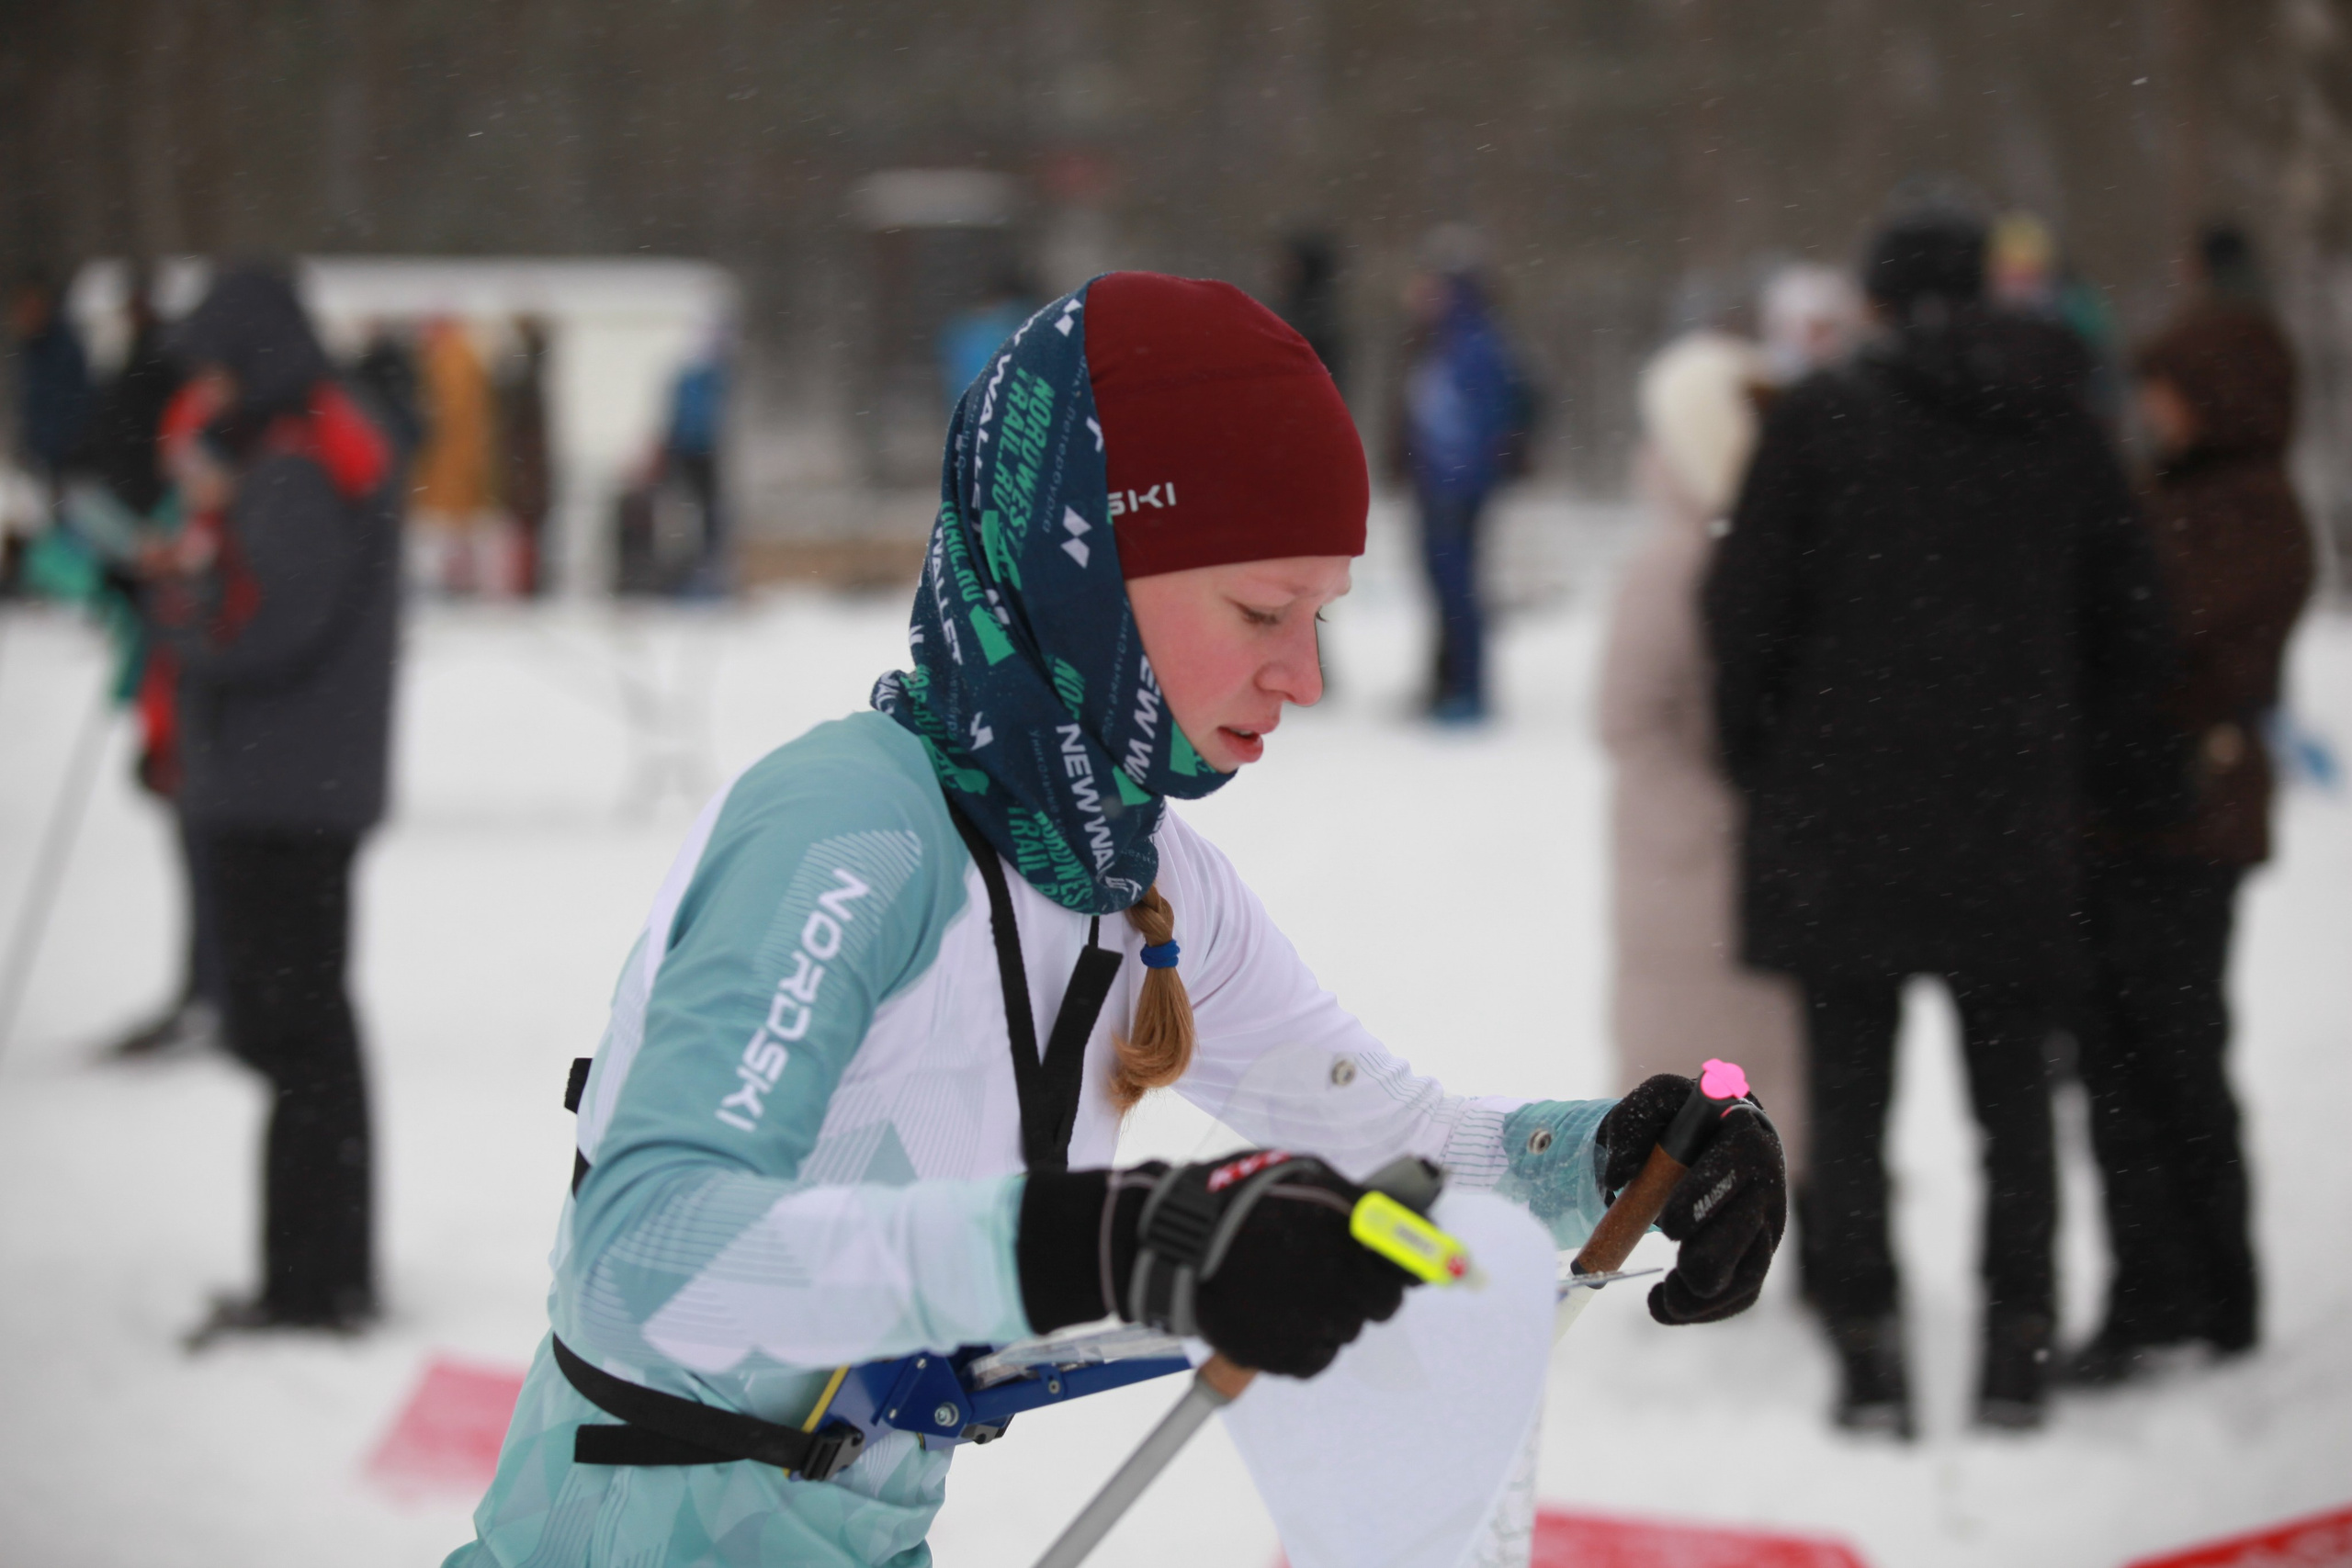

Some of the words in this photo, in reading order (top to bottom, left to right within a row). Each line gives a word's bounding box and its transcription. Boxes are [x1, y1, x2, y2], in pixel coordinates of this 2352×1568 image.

[1136, 653, 1162, 739] EW
[1056, 722, 1103, 813] NEW
[714, 867, 870, 1133] NORDSKI
